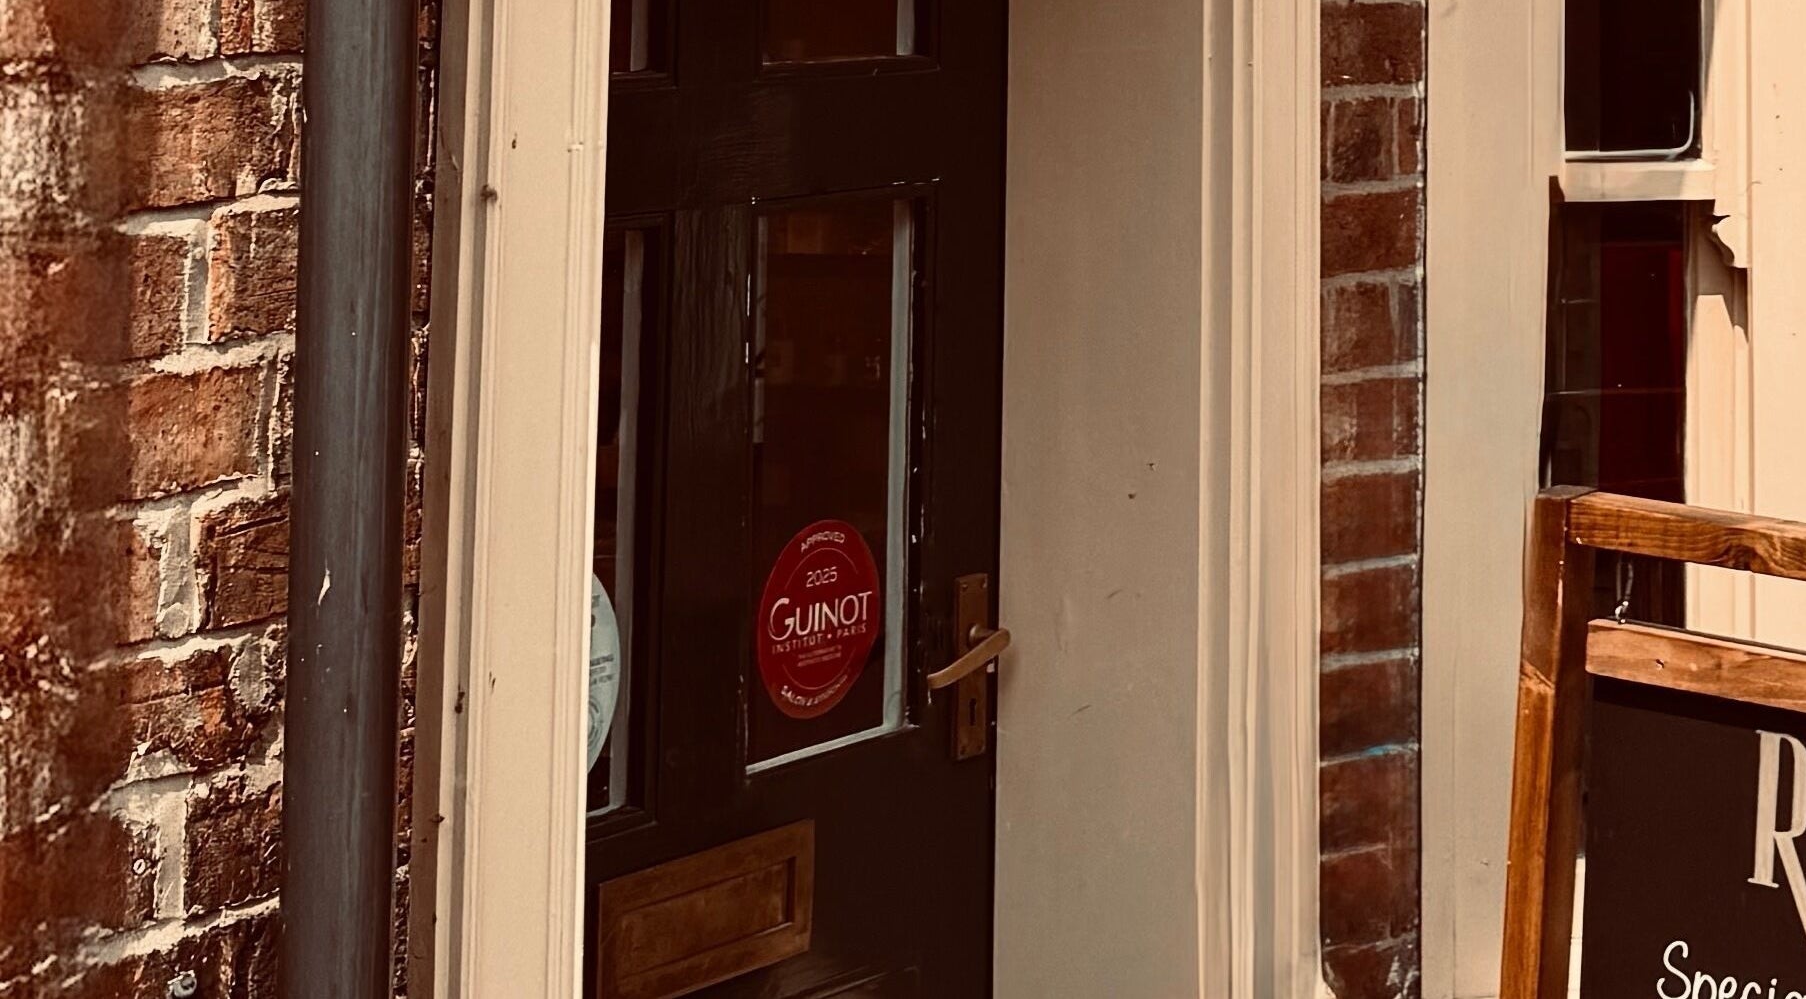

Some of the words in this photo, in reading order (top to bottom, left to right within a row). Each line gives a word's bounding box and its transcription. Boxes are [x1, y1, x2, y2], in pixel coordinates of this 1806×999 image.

[806, 566, 838, 588] 2025
[768, 591, 872, 641] GUINOT
[772, 633, 824, 655] INSTITUT
[836, 623, 867, 639] PARIS
